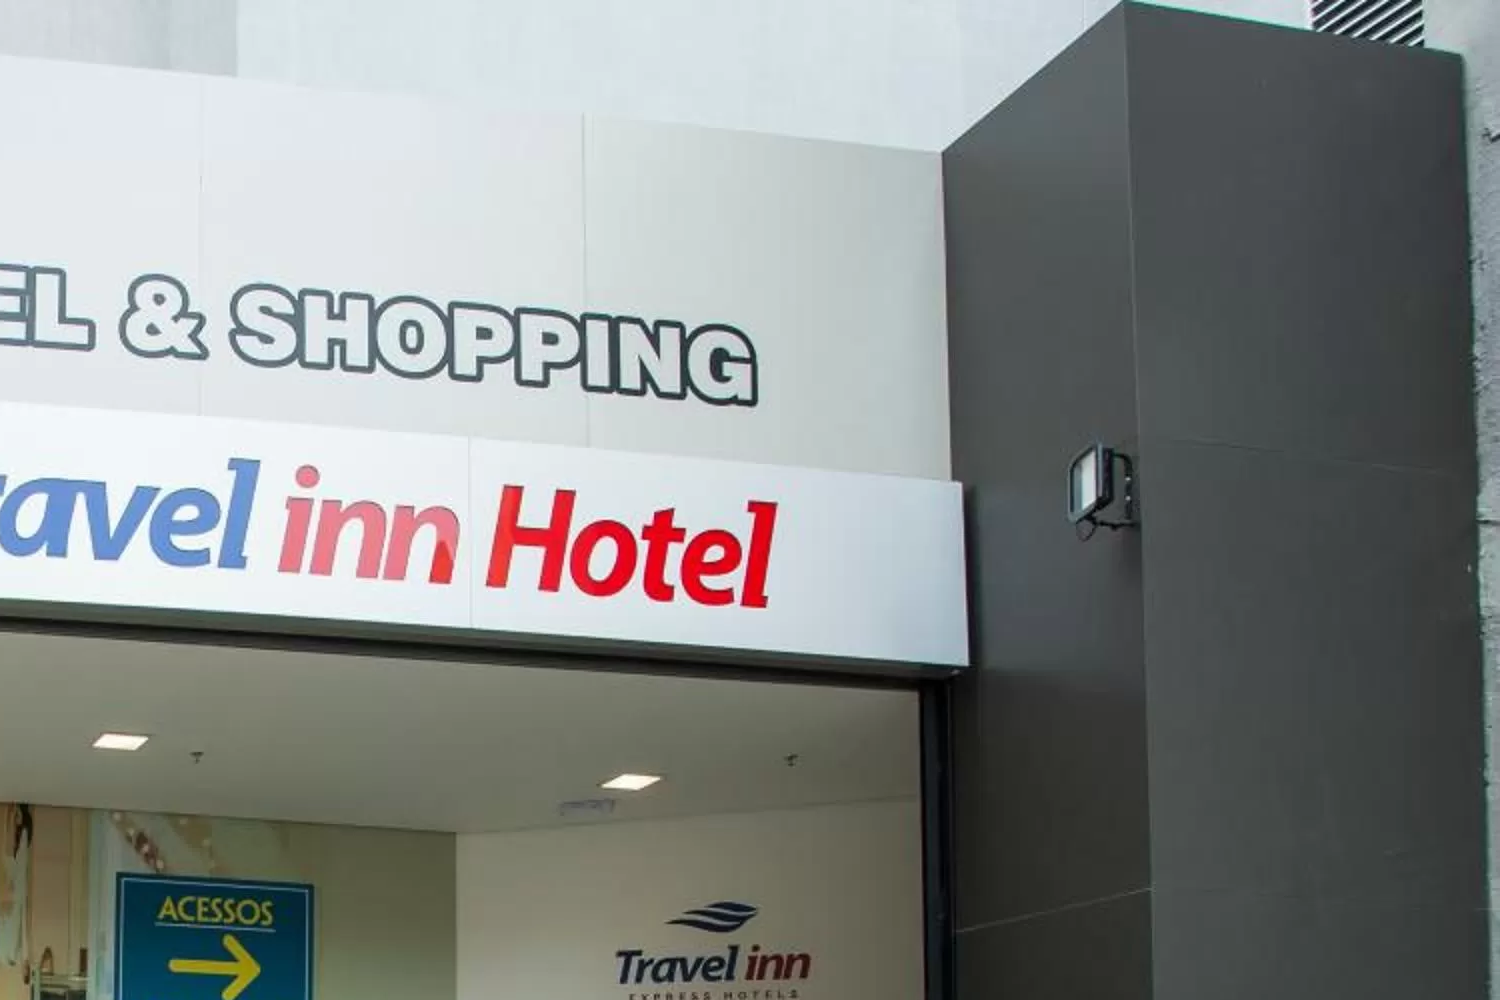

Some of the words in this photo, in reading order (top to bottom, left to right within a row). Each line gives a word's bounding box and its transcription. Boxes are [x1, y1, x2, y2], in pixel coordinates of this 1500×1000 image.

[119, 274, 208, 360] &
[229, 284, 758, 406] SHOPPING
[278, 464, 460, 584] inn
[486, 485, 778, 608] Hotel
[158, 896, 273, 926] ACESSOS
[616, 944, 739, 984] Travel
[745, 945, 812, 980] inn
[723, 989, 799, 1000] HOTELS
